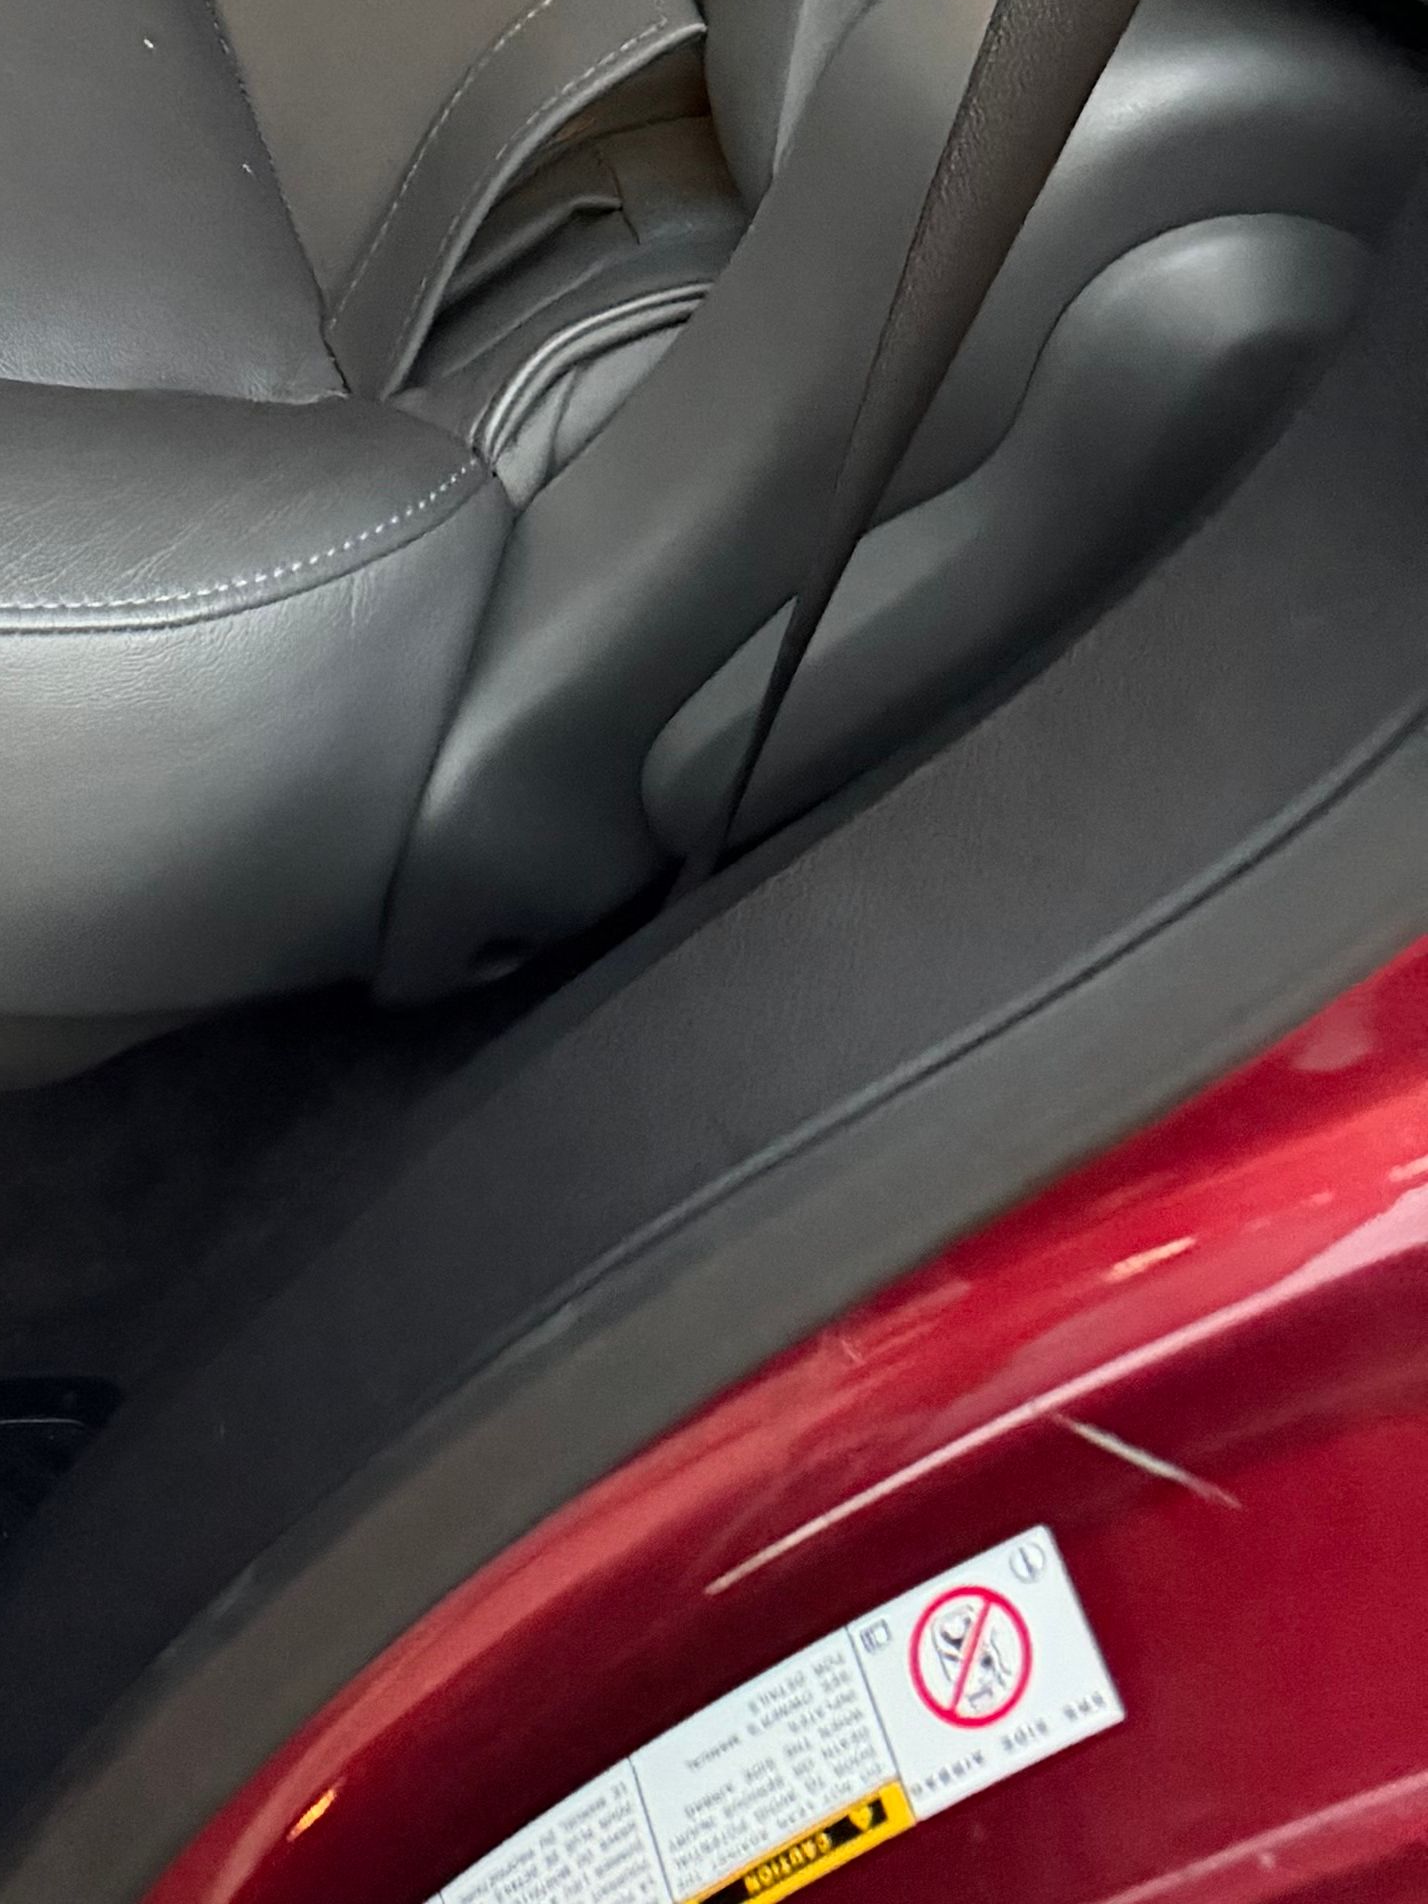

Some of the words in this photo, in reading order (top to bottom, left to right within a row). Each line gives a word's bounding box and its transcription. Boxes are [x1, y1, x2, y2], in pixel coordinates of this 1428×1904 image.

[998, 1716, 1050, 1754] SIDE
[908, 1749, 987, 1797] AIRBAG
[740, 1829, 835, 1895] CAUTION
